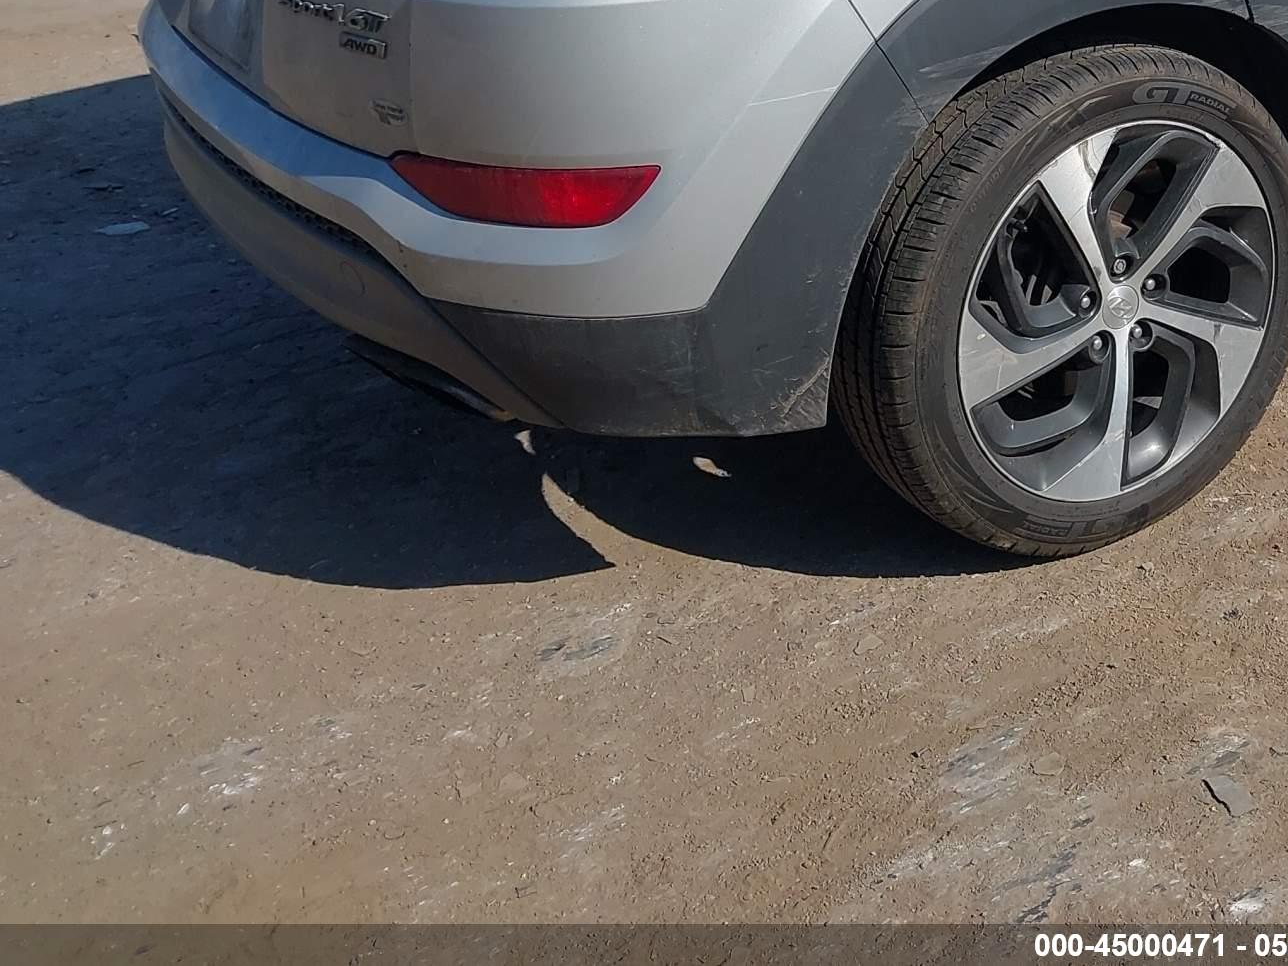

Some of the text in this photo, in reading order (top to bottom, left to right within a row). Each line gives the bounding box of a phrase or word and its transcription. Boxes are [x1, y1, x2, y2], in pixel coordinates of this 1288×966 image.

[343, 37, 377, 55] AWD
[1132, 81, 1232, 115] GT RADIAL
